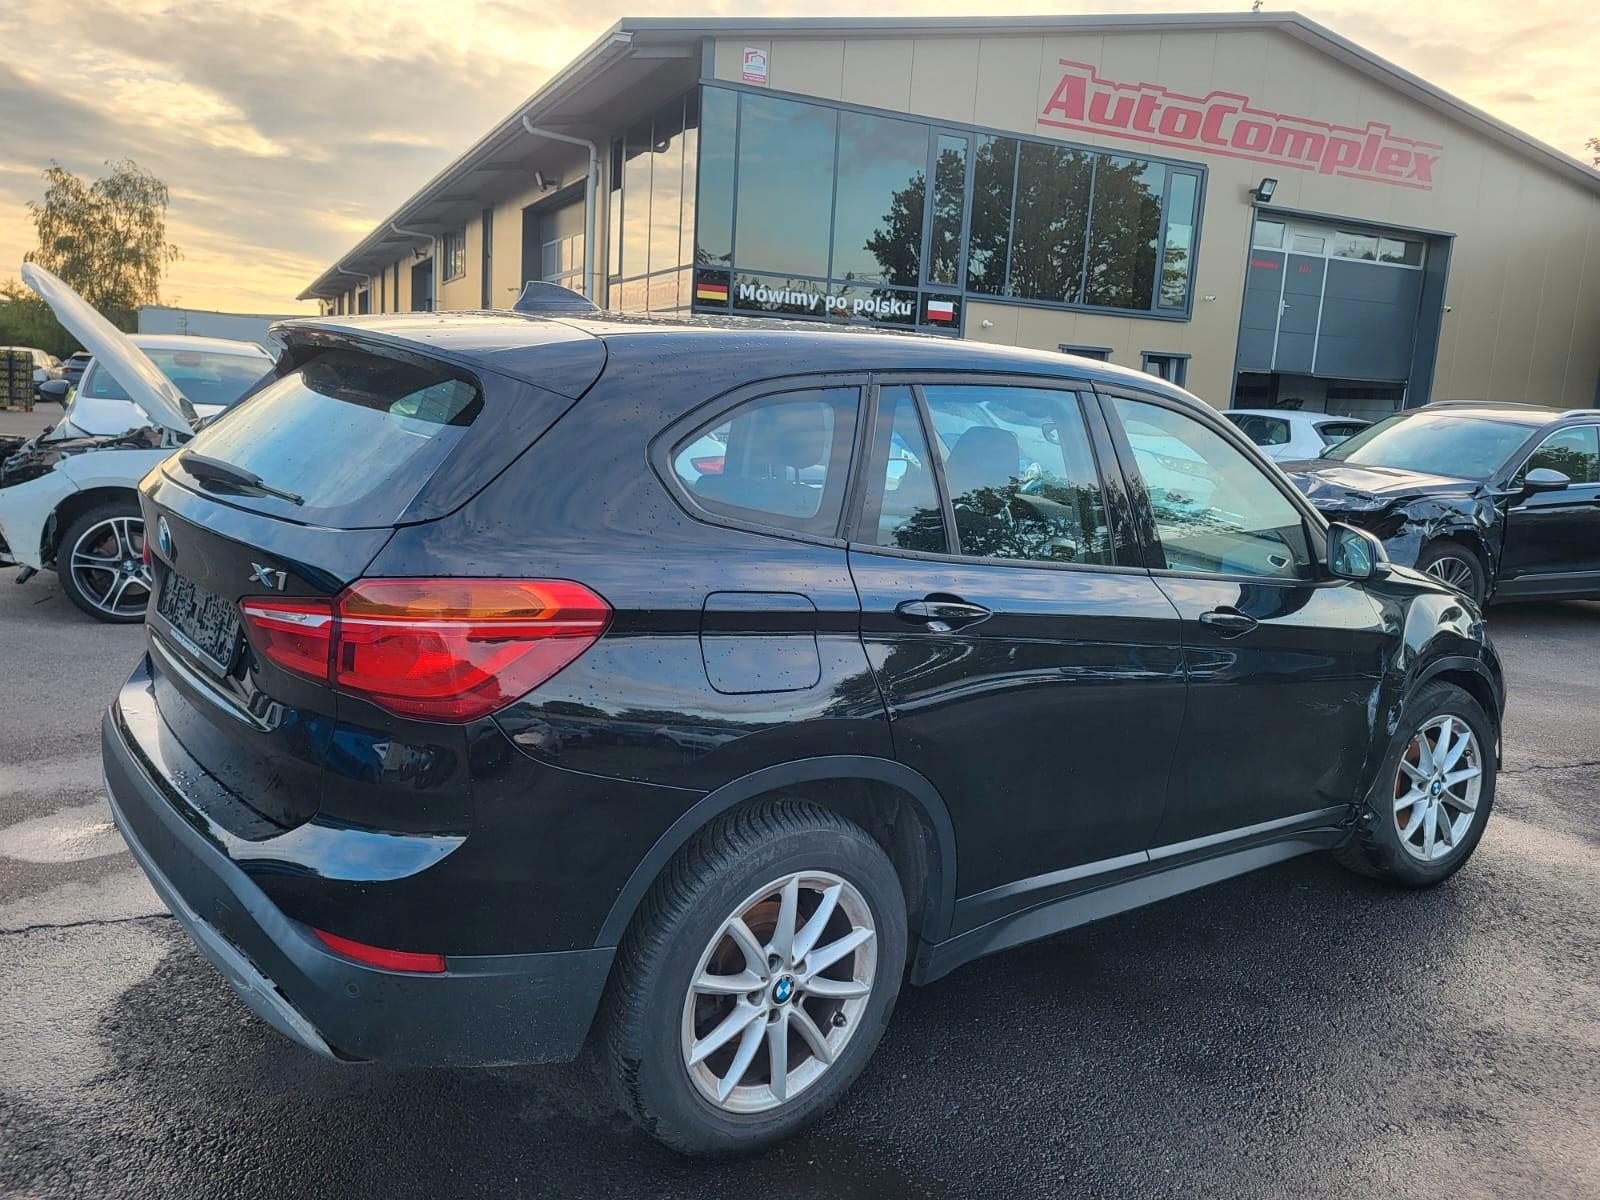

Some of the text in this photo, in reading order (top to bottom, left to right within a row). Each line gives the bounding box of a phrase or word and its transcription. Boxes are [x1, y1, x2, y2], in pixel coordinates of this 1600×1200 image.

[1043, 74, 1439, 182] AutoComplex
[739, 283, 912, 315] Mówimy po polsku
[249, 562, 287, 591] X1
